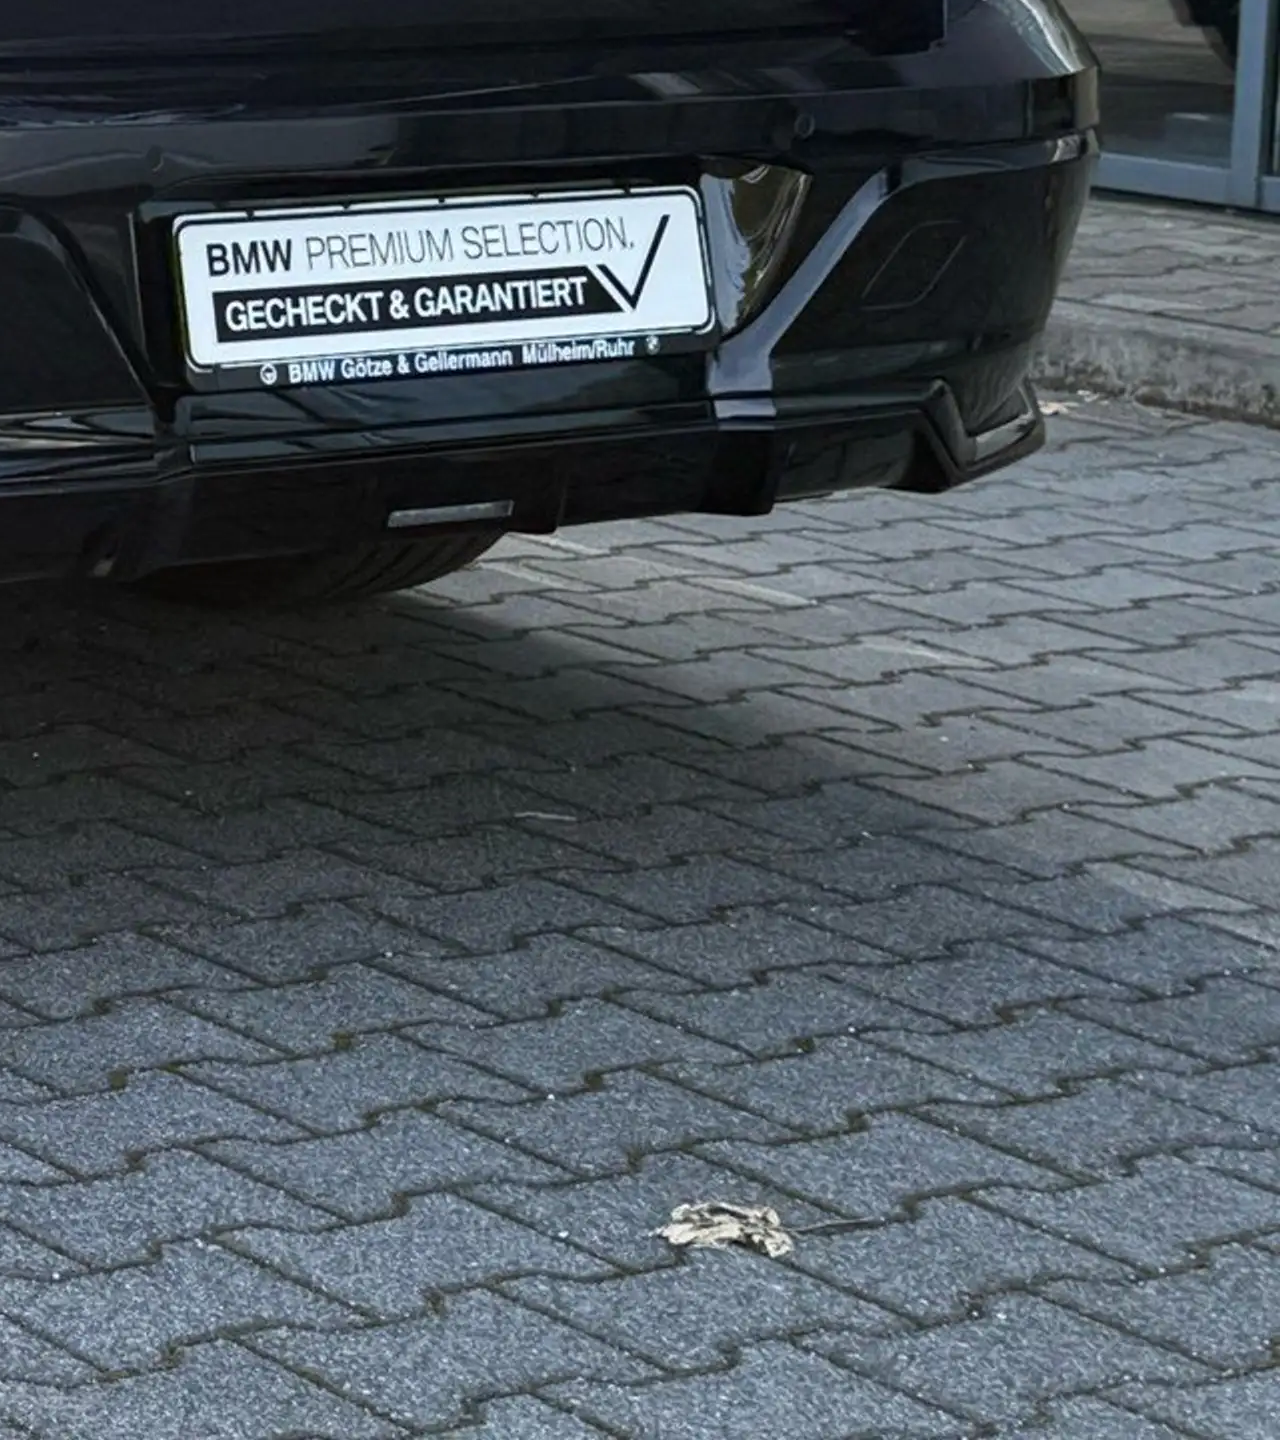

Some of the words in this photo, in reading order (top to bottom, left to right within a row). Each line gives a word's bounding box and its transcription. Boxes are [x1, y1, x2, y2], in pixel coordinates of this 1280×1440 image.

[206, 239, 292, 277] BMW
[306, 228, 454, 270] PREMIUM
[461, 216, 635, 260] SELECTION.
[225, 291, 384, 332] GECHECKT
[390, 289, 410, 320] &
[413, 276, 588, 318] GARANTIERT
[288, 362, 336, 384] BMW
[341, 356, 393, 379] Götze
[397, 353, 411, 374] &
[414, 348, 513, 373] Gellermann
[522, 337, 636, 365] Mülheim/Ruhr
